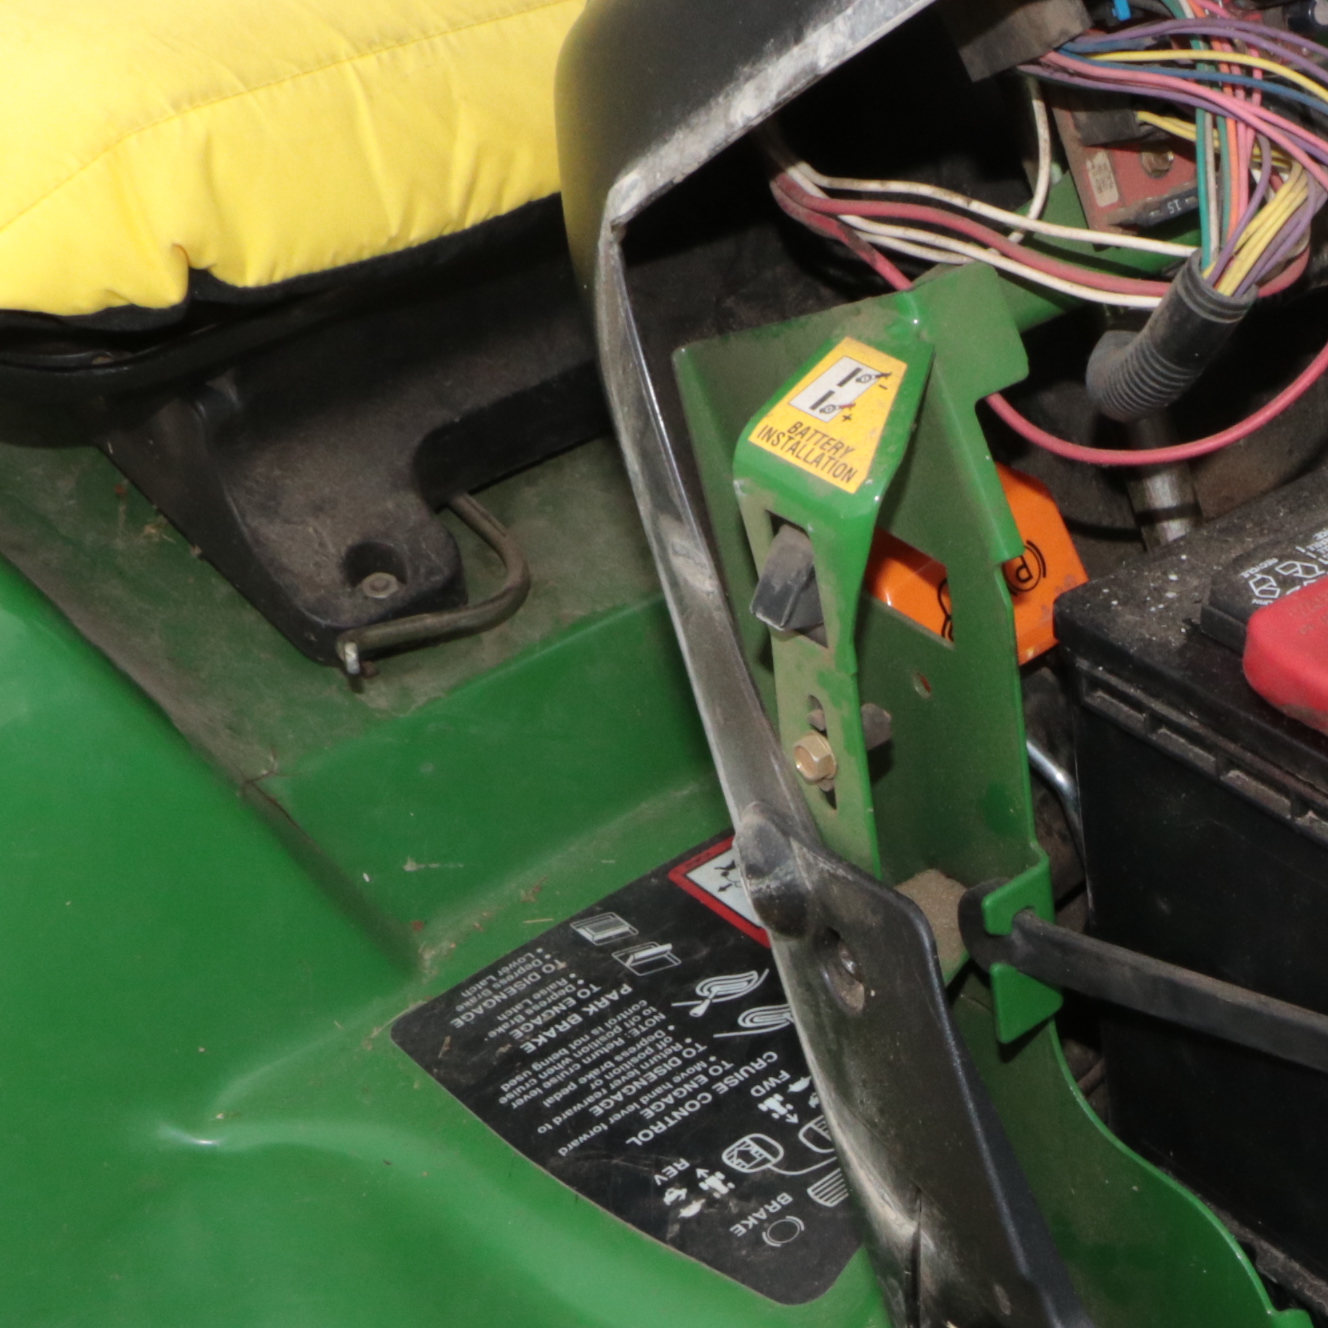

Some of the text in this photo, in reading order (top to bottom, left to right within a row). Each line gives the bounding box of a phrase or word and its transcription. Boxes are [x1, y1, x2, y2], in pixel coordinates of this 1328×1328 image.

[757, 424, 858, 483] INSTALLATION
[787, 420, 854, 460] BATTERY
[448, 958, 563, 1028] TO DISENGAGE
[453, 956, 543, 1012] Depress Brake
[460, 951, 534, 998] Lower Latch
[496, 976, 567, 1021] Raise Latch
[487, 982, 576, 1038] Depress Brake
[508, 981, 601, 1039] TO ENGAGE
[519, 982, 633, 1053] PARK BRAKE
[497, 1004, 657, 1104] to off position when cruise
[499, 999, 648, 1091] control is not being used
[509, 1011, 665, 1108] NOTE: Return cruise lever
[540, 1027, 666, 1106] Depress brake pedal
[587, 1035, 673, 1089] off position or
[536, 1041, 682, 1134] Return lever rearward to
[557, 1059, 707, 1155] Move hand lever forward
[587, 1040, 707, 1116] TO DISENGAGE
[625, 1050, 778, 1149] CRUISE CONTROL
[638, 1058, 733, 1119] TO ENGAGE
[749, 1069, 790, 1097] FWD
[652, 1157, 690, 1183] REV
[728, 1192, 793, 1236] BRAKE
